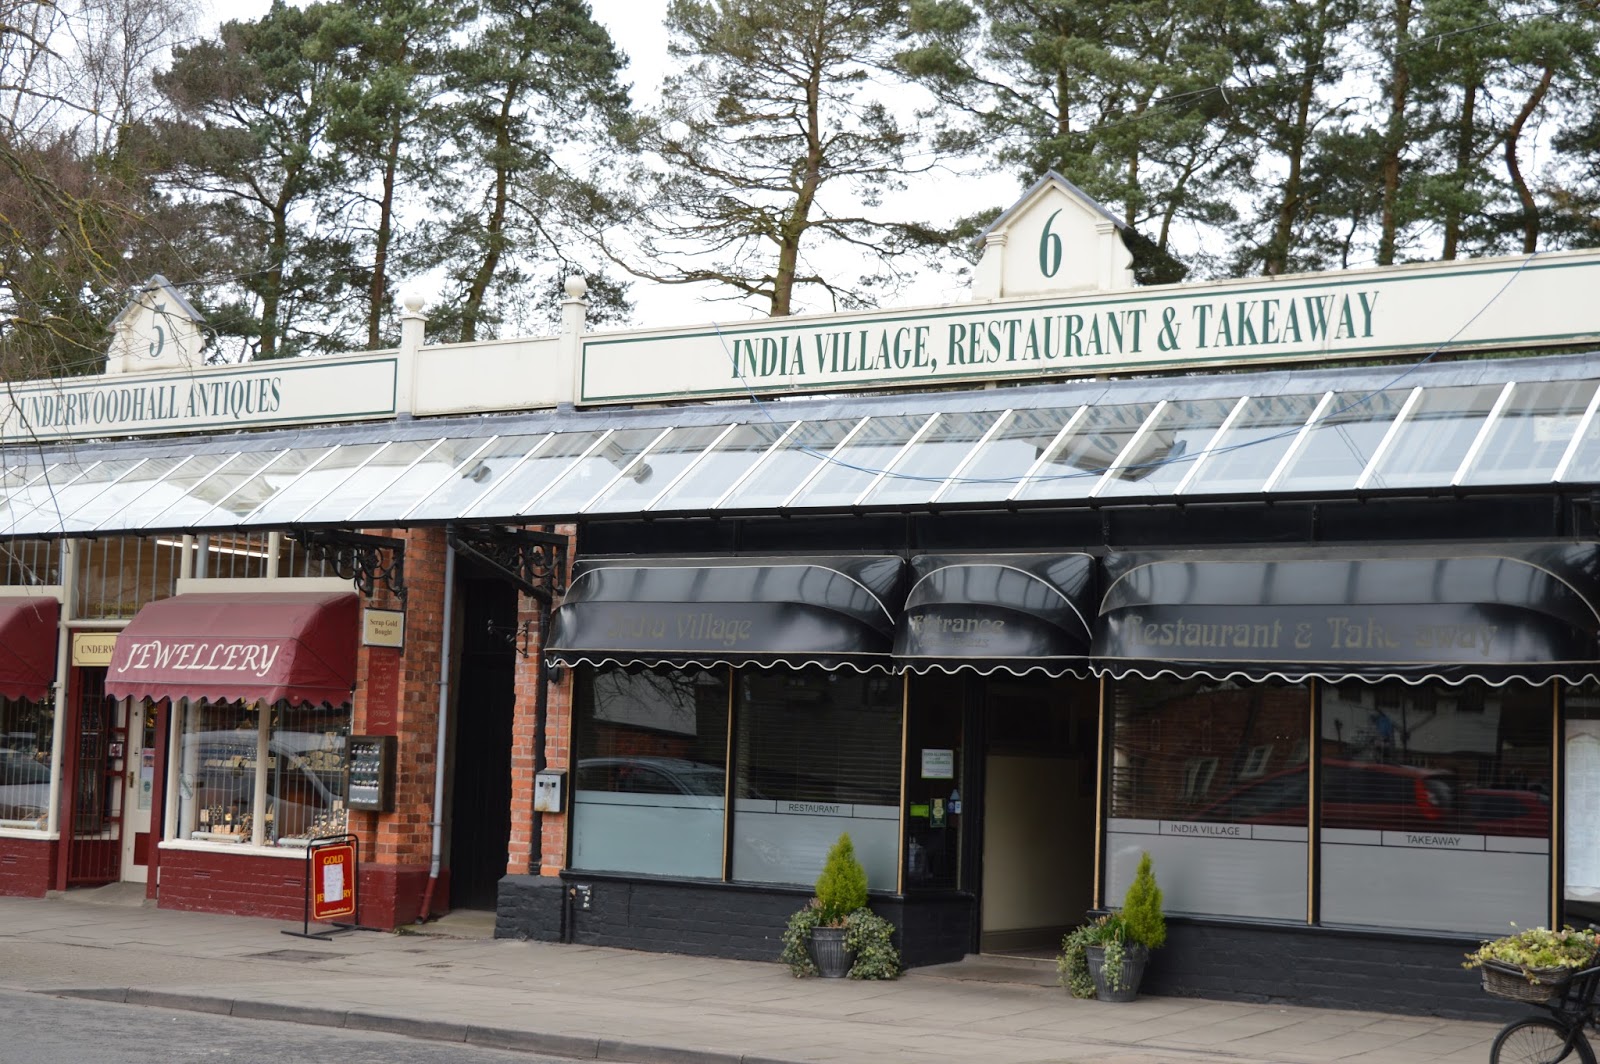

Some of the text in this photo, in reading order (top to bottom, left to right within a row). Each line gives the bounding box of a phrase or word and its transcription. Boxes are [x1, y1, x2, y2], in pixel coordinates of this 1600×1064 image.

[1038, 207, 1064, 279] 6
[149, 302, 167, 358] 5
[731, 290, 1380, 379] INDIA VILLAGE, RESTAURANT & TAKEAWAY
[184, 376, 282, 420] ANTIQUES
[369, 618, 398, 628] Scrap Gold
[374, 627, 393, 636] Bought
[676, 612, 753, 646] Village
[1124, 613, 1283, 649] Restaurant
[1294, 622, 1313, 649] &
[1326, 615, 1404, 649] Take
[117, 639, 280, 677] JEWELLERY
[788, 803, 840, 814] RESTAURANT
[1170, 824, 1240, 836] INDIA VILLAGE
[1405, 834, 1461, 846] TAKEAWAY
[323, 854, 344, 866] GOLD
